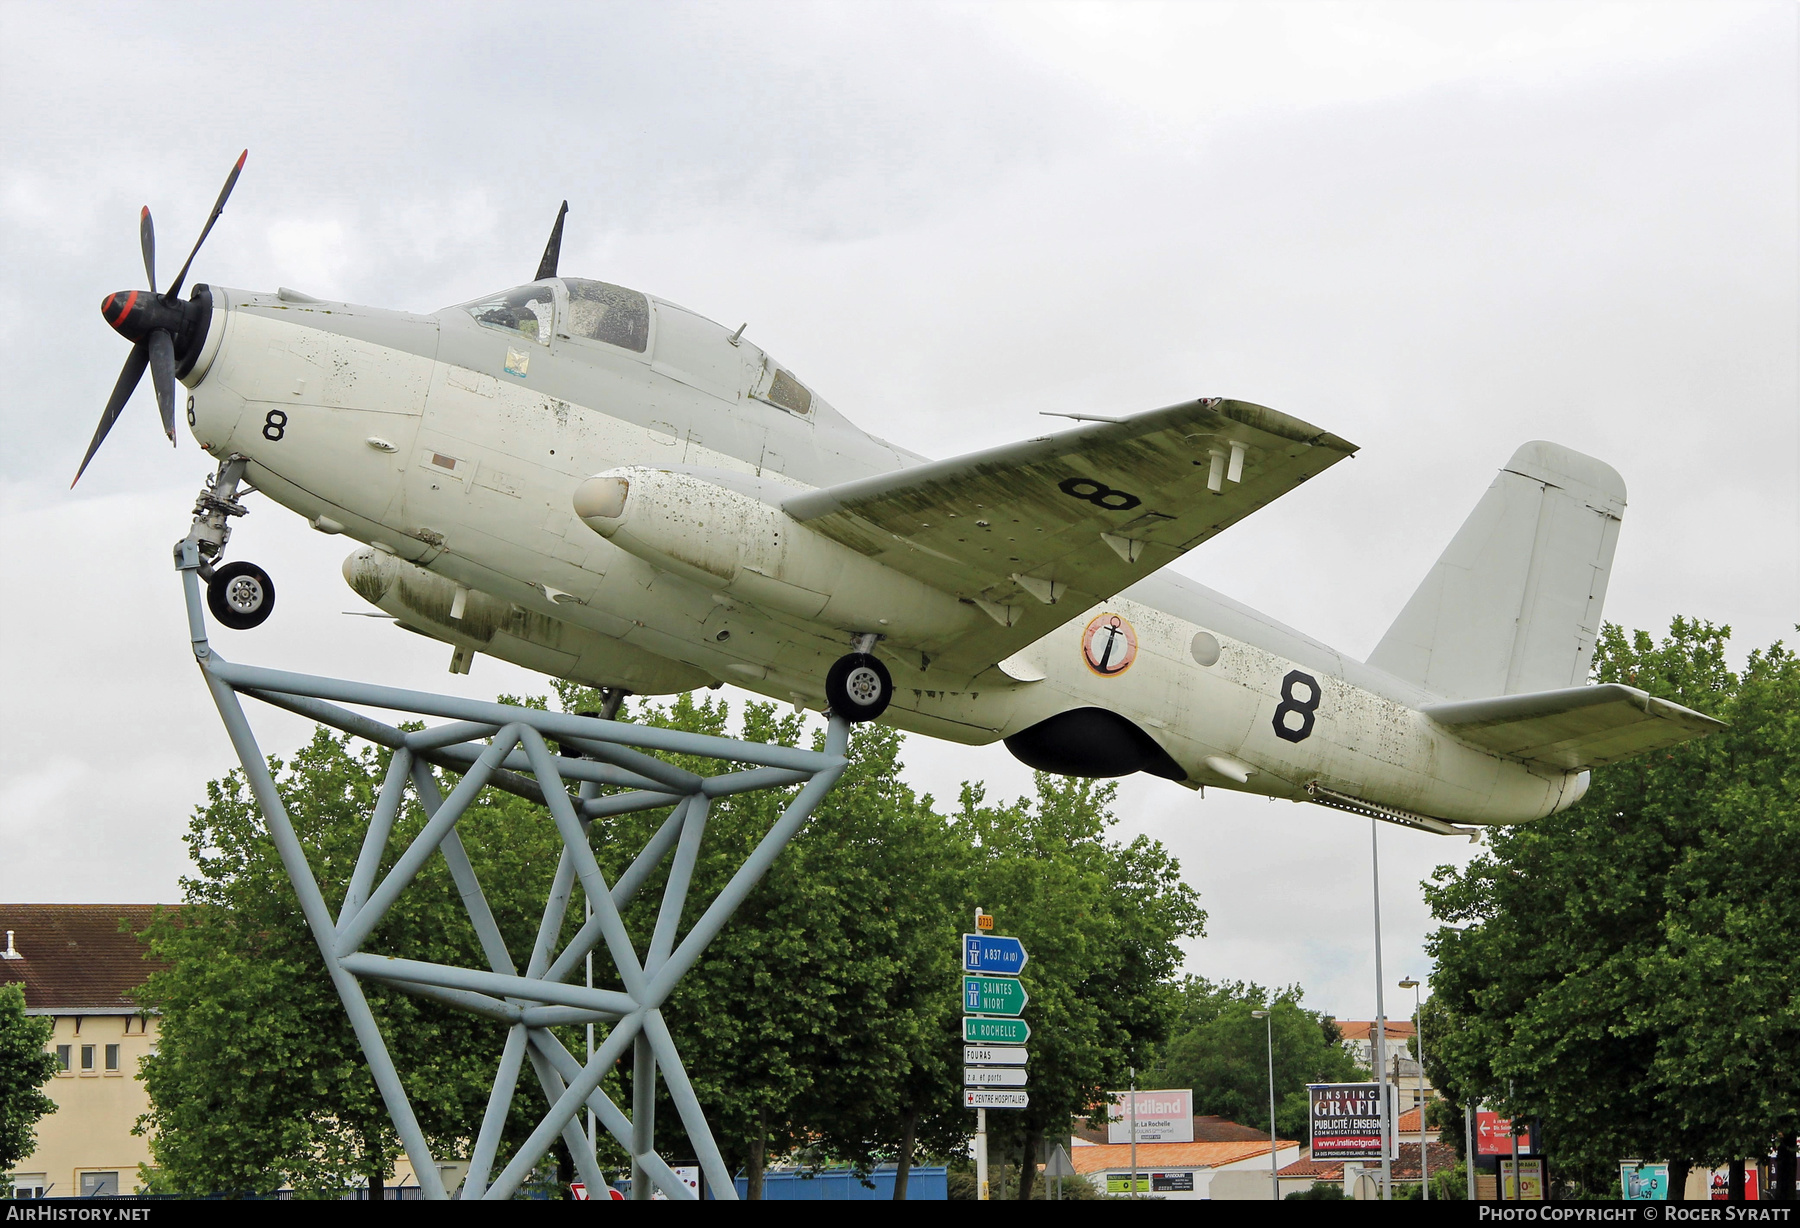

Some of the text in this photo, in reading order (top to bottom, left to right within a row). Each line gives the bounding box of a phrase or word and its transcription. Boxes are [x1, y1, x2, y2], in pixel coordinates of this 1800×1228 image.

[262, 409, 288, 442] 8
[1057, 477, 1142, 511] 8
[1272, 669, 1322, 744] 8
[978, 917, 992, 927] D733
[983, 982, 1012, 995] SAINTES
[983, 998, 1004, 1010] NIORT
[968, 1024, 1016, 1037] LA ROCHELLE
[967, 1050, 991, 1060] FOURAS
[979, 1073, 985, 1081] et
[987, 1073, 1002, 1083] ports
[975, 1094, 1026, 1104] CENTRE HOSPITALIER
[1320, 1090, 1380, 1100] INSTINC
[1119, 1099, 1181, 1114] Jardiland
[1314, 1117, 1348, 1130] PUBLICITÉ
